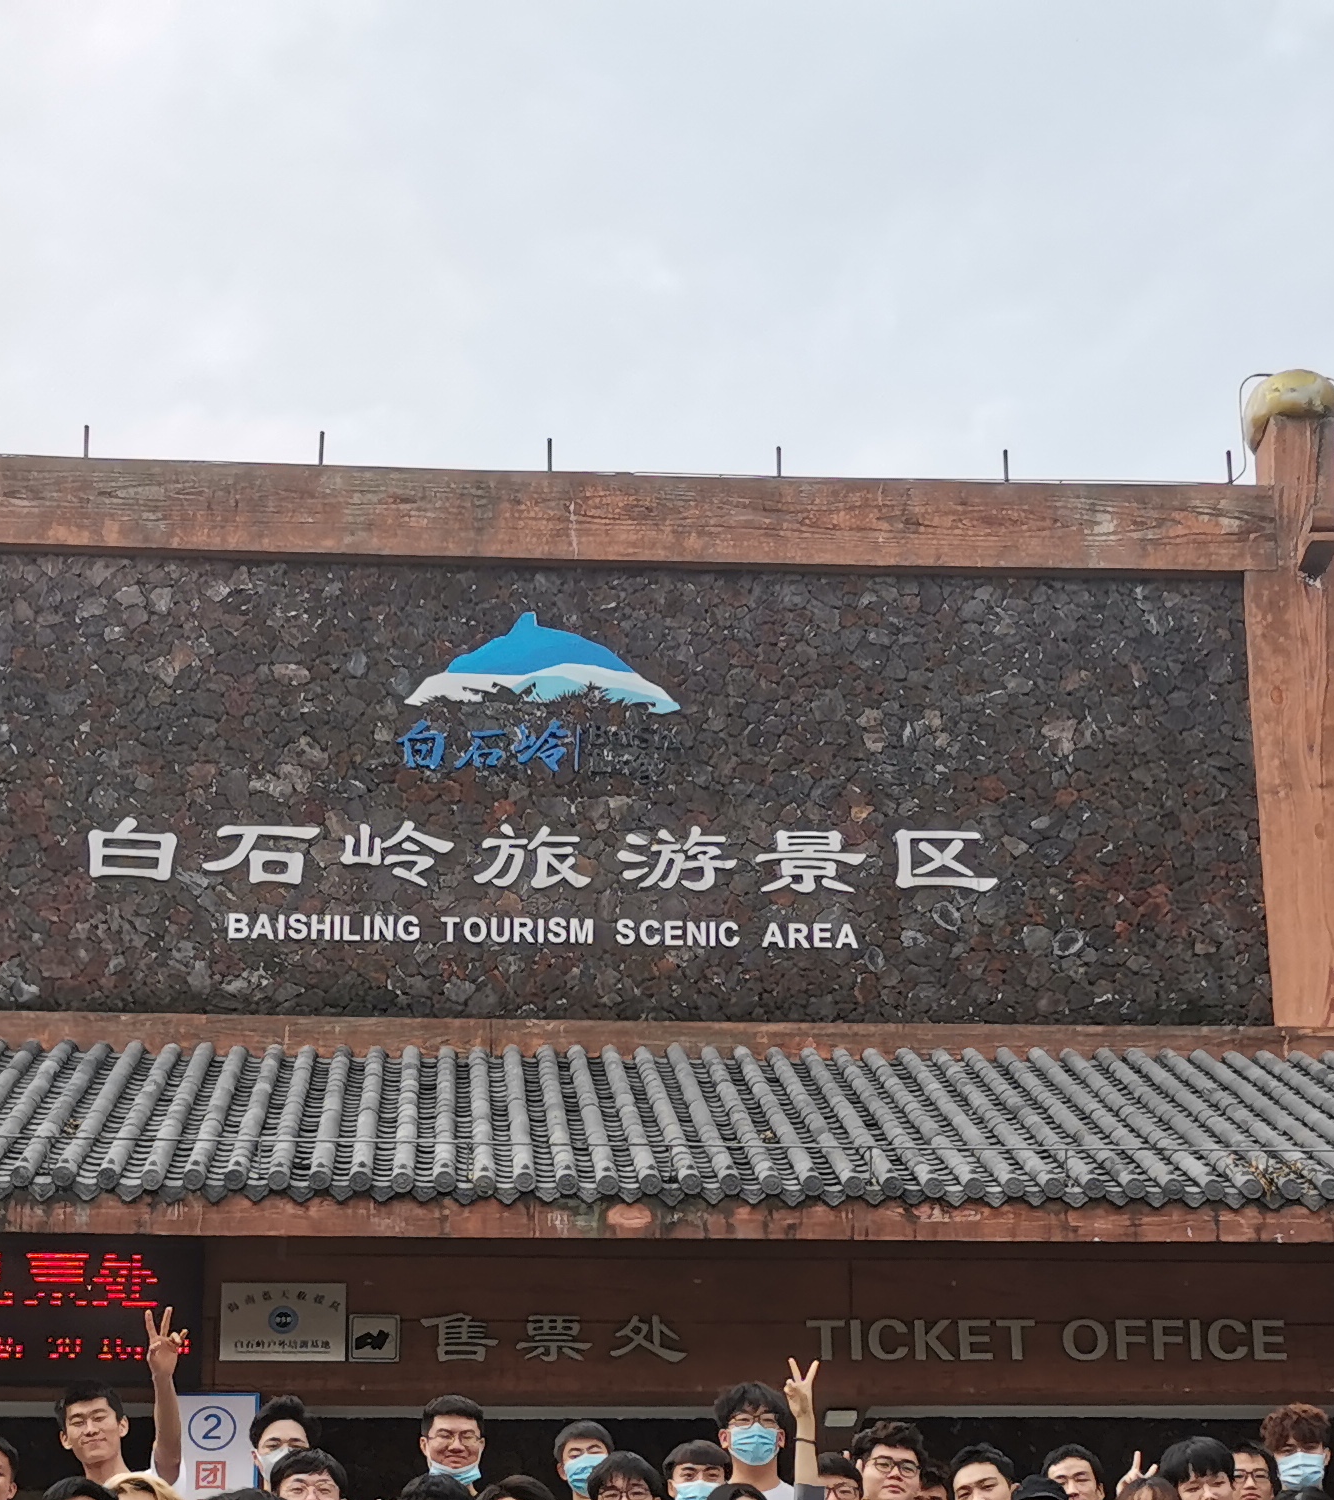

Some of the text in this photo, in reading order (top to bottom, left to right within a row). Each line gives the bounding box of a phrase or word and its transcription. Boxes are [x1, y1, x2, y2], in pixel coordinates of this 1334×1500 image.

[396, 719, 568, 773] 白石岭
[87, 816, 998, 894] 白石岭旅游景区
[227, 912, 859, 949] BAISHILING TOURISM SCENIC AREA
[420, 1312, 688, 1364] 售票处
[806, 1318, 1288, 1363] TICKET OFFICE
